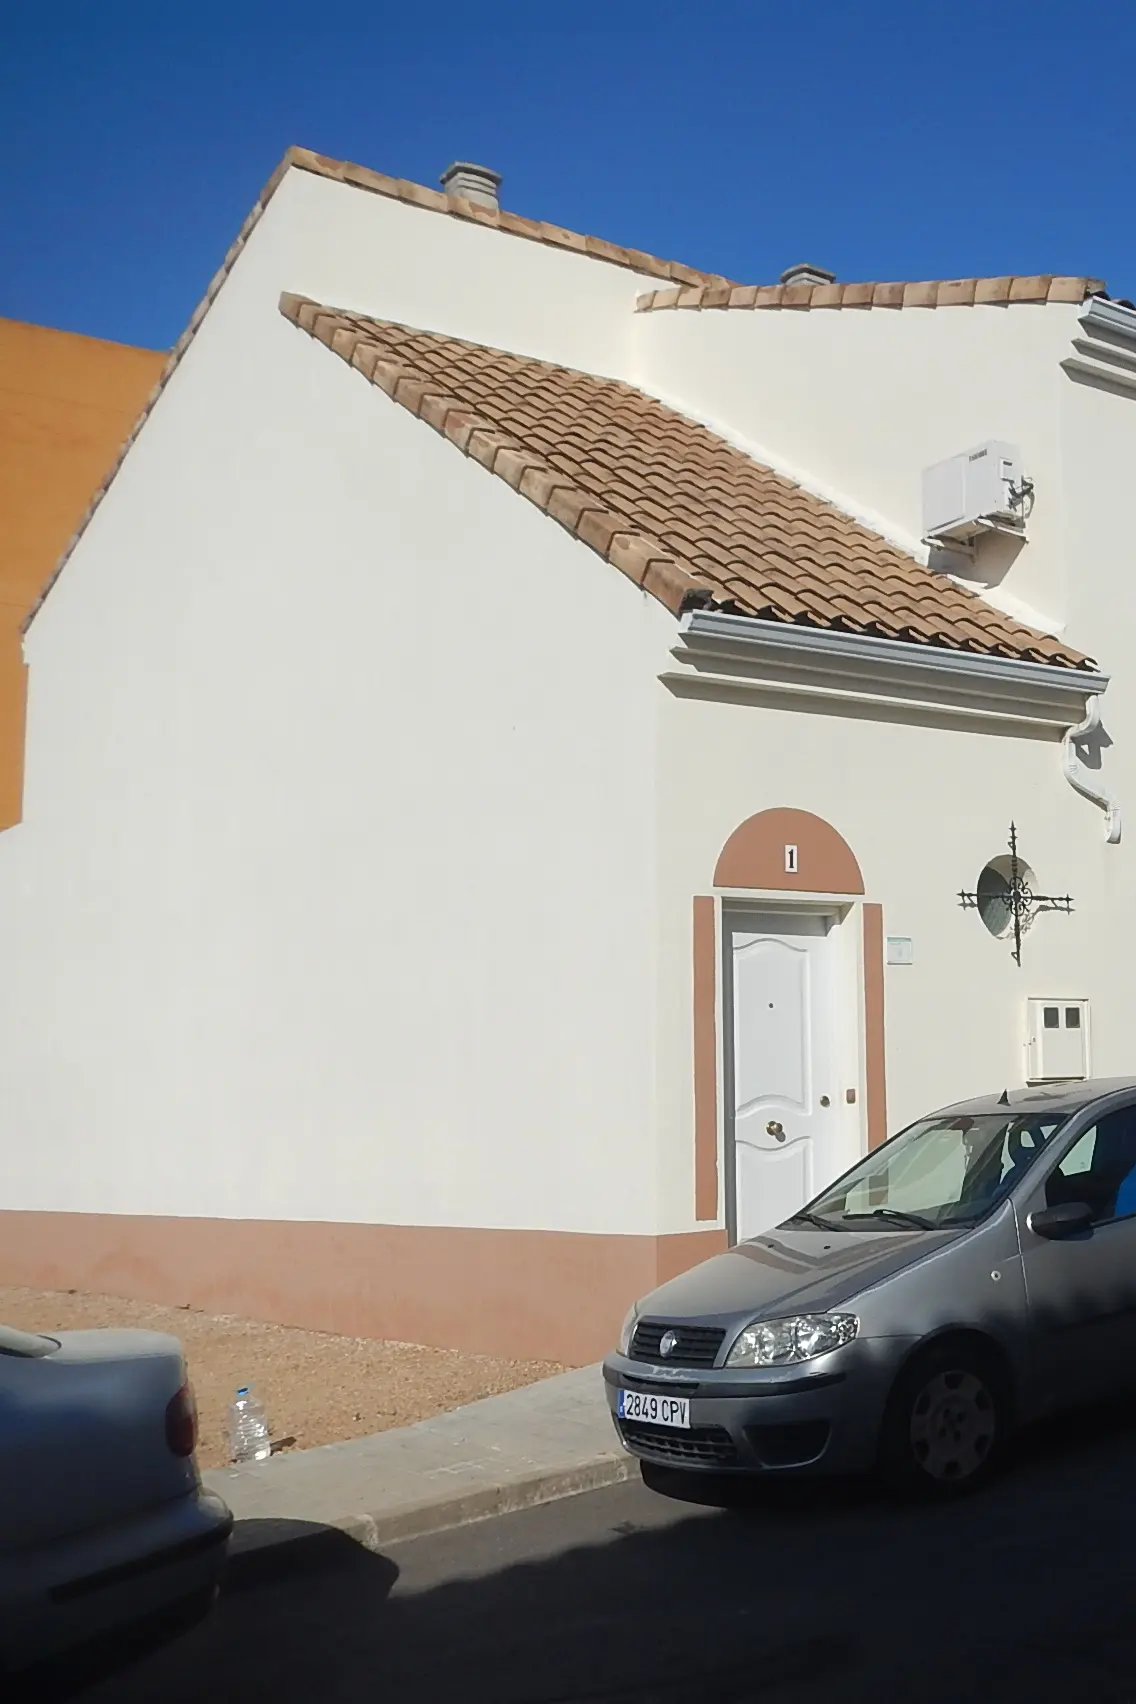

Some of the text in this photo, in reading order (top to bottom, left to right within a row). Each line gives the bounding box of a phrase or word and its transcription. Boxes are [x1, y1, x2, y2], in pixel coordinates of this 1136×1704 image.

[788, 849, 795, 869] 1
[626, 1394, 687, 1425] 2849 CPV
